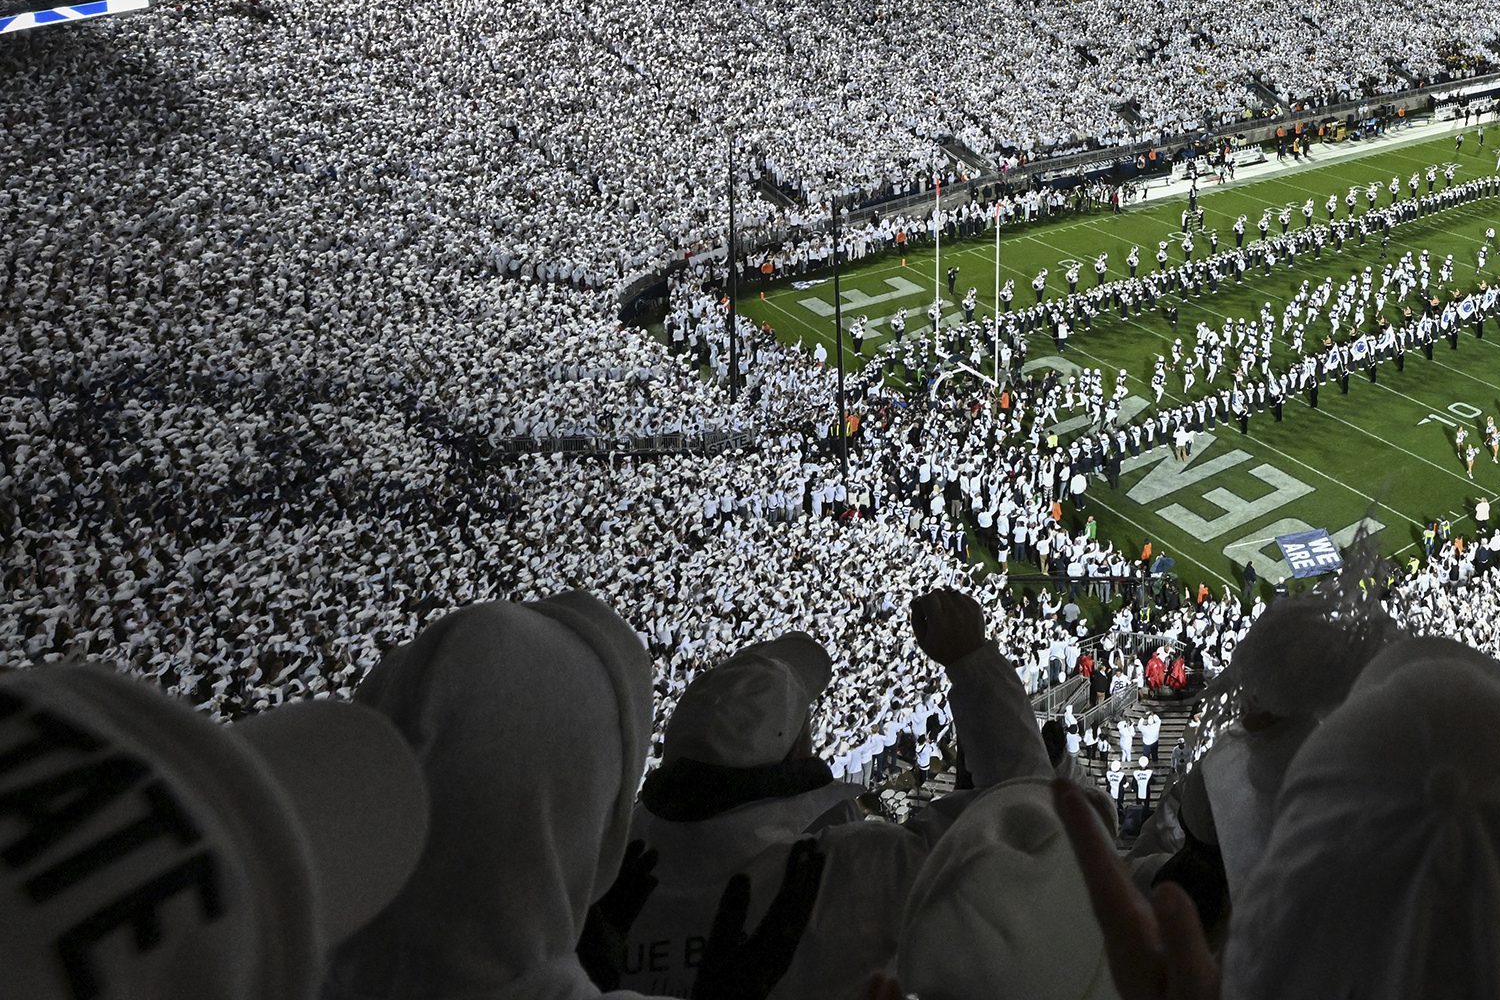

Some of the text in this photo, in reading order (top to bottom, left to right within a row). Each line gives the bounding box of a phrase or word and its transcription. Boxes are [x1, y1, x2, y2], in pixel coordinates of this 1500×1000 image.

[1428, 401, 1483, 428] 10
[709, 434, 747, 455] STATE
[1282, 543, 1316, 570] ARE
[1308, 536, 1341, 565] WE
[0, 690, 224, 1000] TATE
